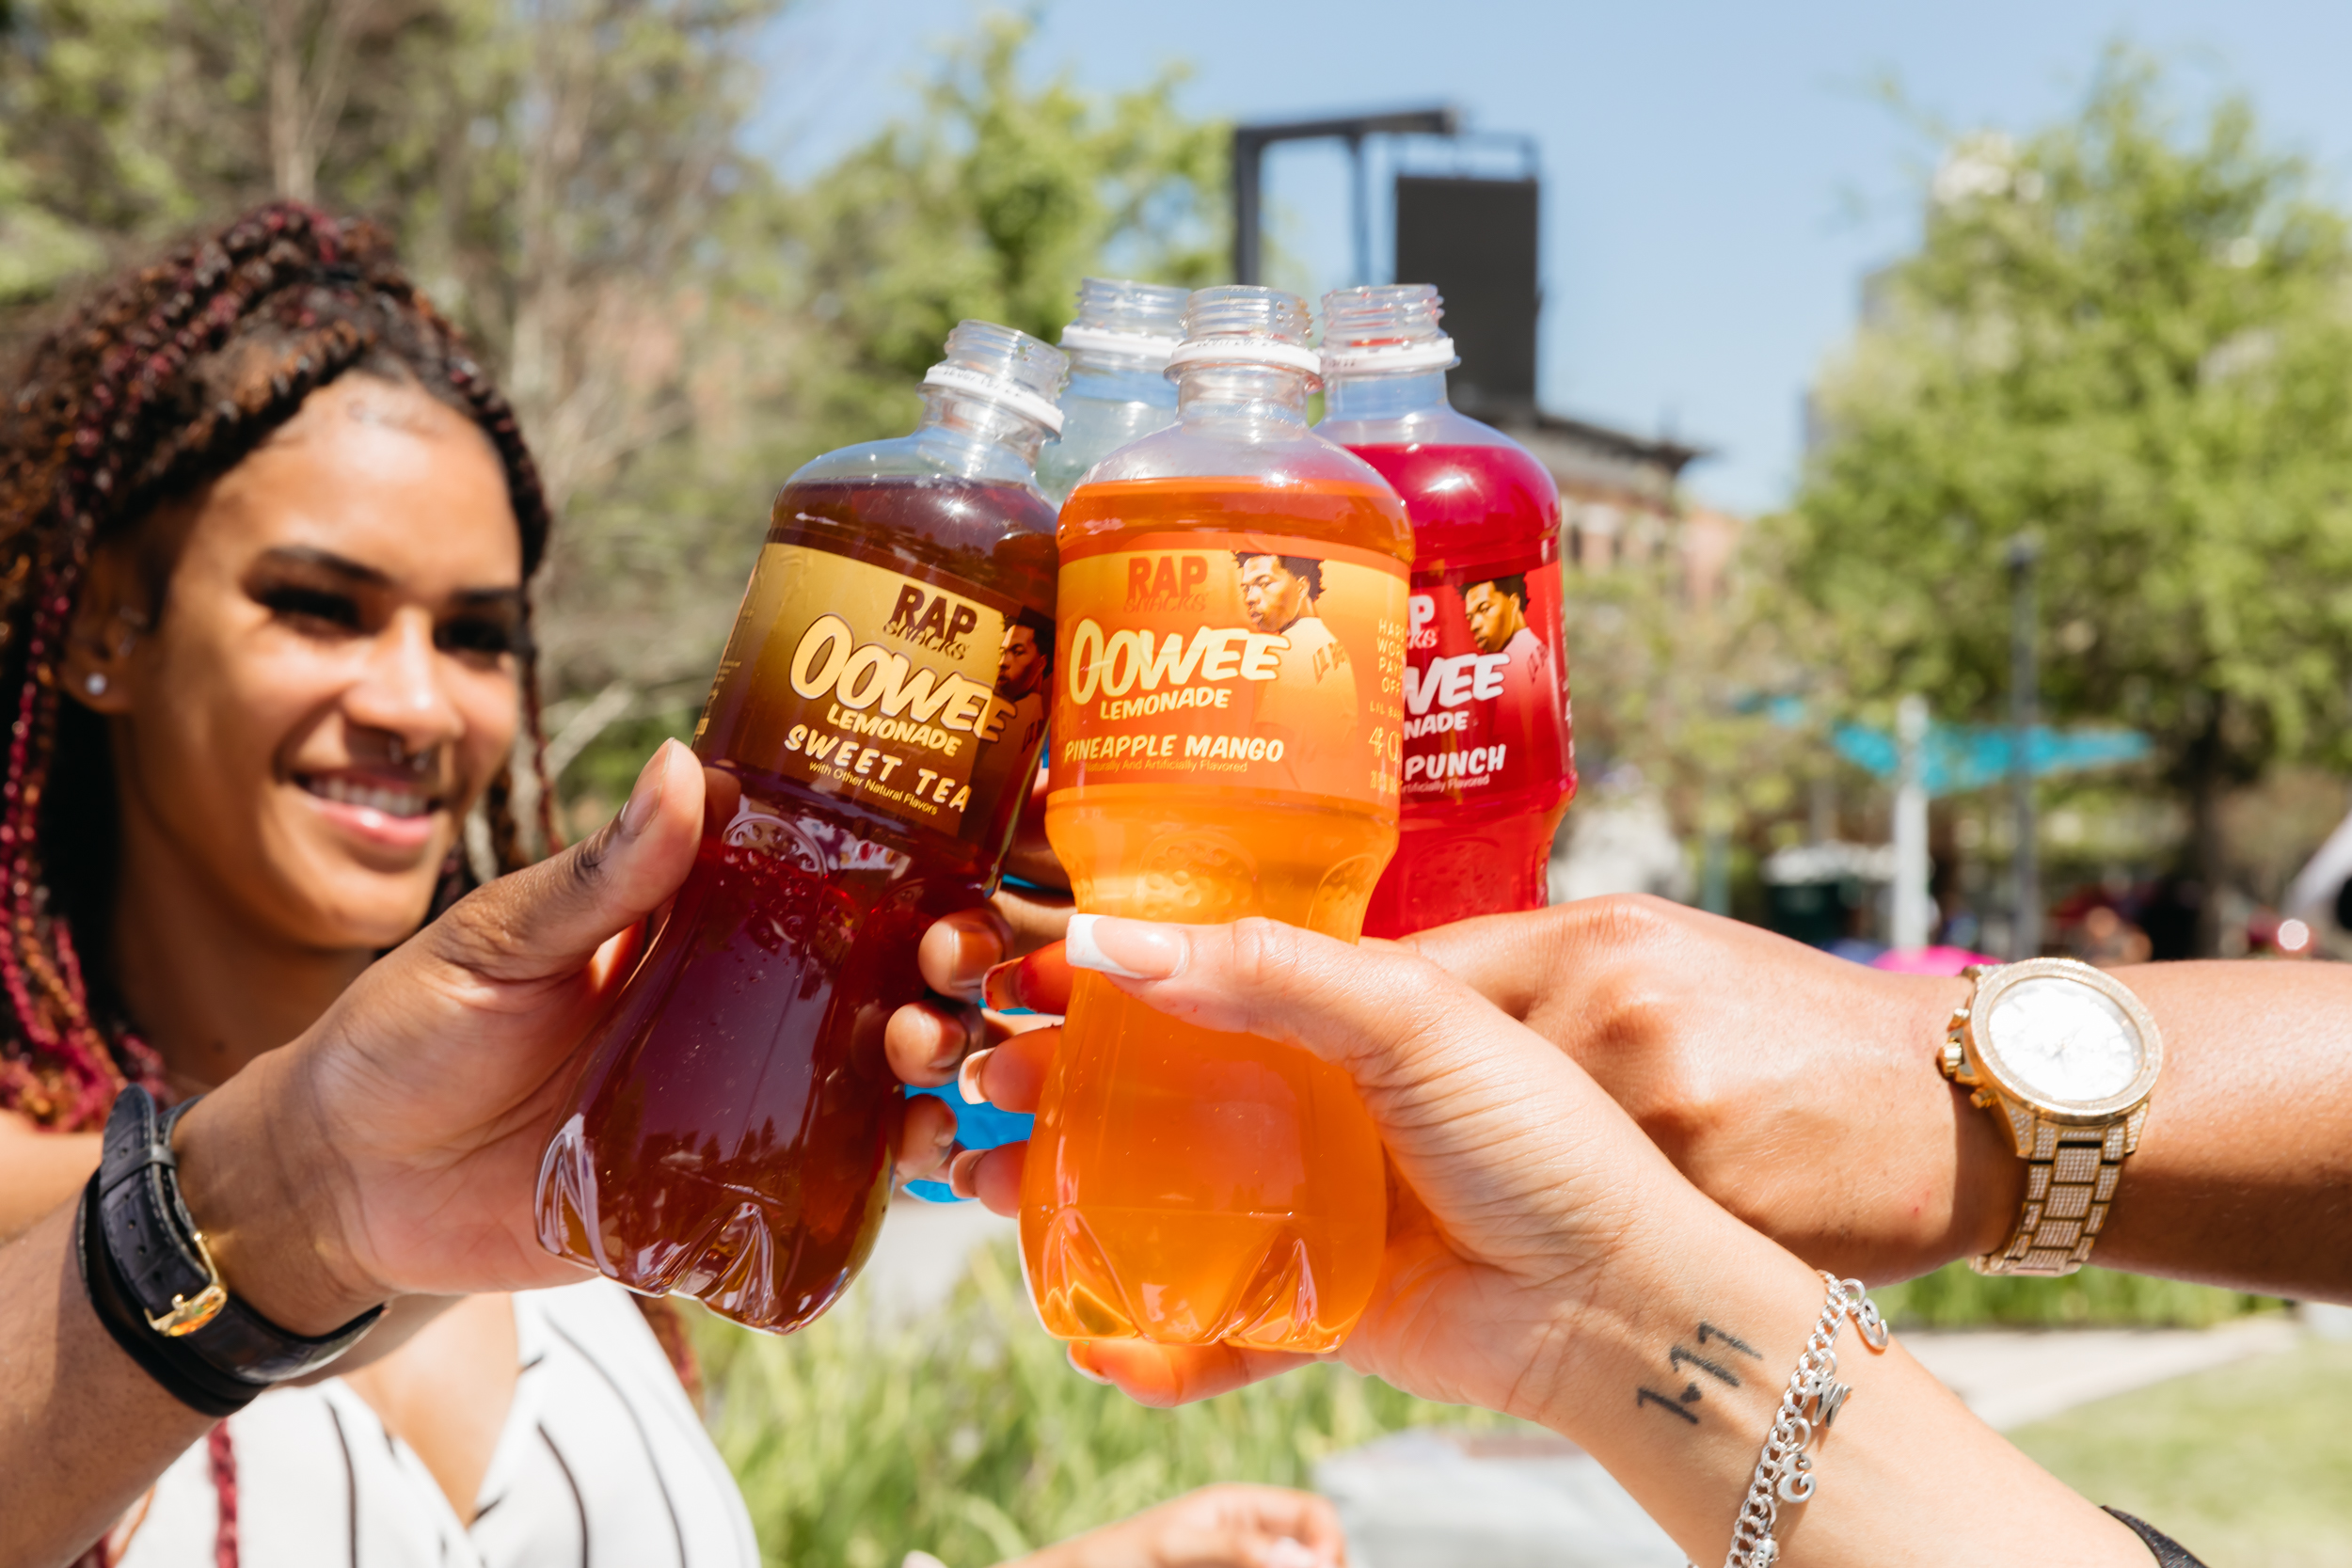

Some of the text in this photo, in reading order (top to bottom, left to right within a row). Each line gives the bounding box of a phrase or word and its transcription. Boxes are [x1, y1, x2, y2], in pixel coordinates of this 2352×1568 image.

[1128, 556, 1208, 600] RAP
[890, 584, 977, 643] RAP
[1123, 594, 1209, 613] SNACKS
[882, 620, 970, 660] SNACKS
[1069, 618, 1291, 705] OOWEE
[789, 612, 1016, 743] OOWEE
[1099, 688, 1232, 721] LEMONADE
[827, 704, 962, 757] LEMONADE
[1064, 734, 1183, 764] PINEAPPLE
[1184, 735, 1285, 763] MANGO
[784, 723, 973, 813] SWEET TEA
[1085, 759, 1248, 773] Naturally And Artificially Flavored
[1406, 743, 1507, 781] PUNCH
[809, 760, 939, 816] with Other Natural Flavors
